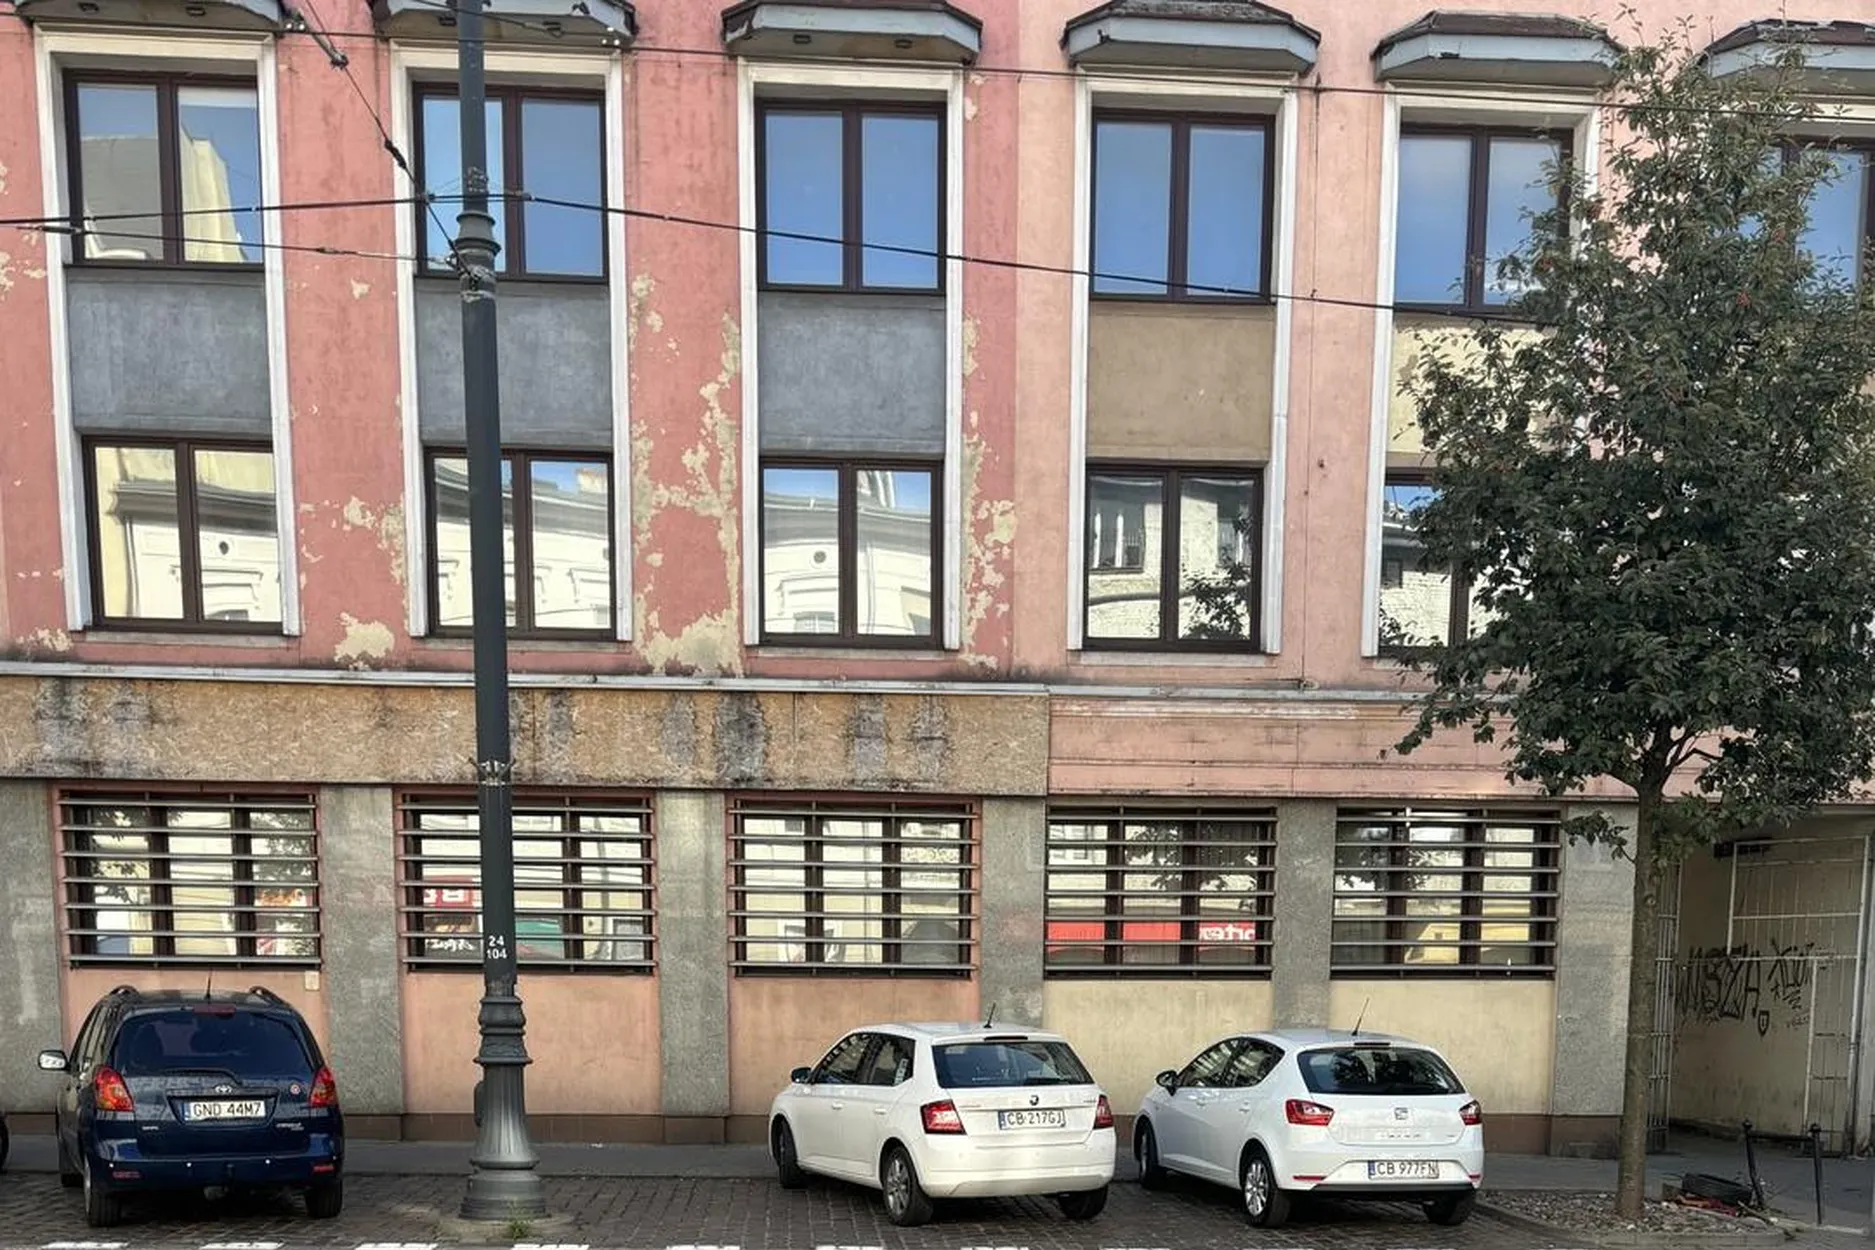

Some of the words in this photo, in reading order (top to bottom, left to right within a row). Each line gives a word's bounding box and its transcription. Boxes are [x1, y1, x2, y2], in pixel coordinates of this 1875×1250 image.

[488, 935, 504, 947] 24
[486, 948, 507, 959] 104
[193, 1103, 222, 1117] GND
[226, 1102, 261, 1115] 44M7
[1007, 1112, 1025, 1125] CB
[1376, 1162, 1395, 1175] CB
